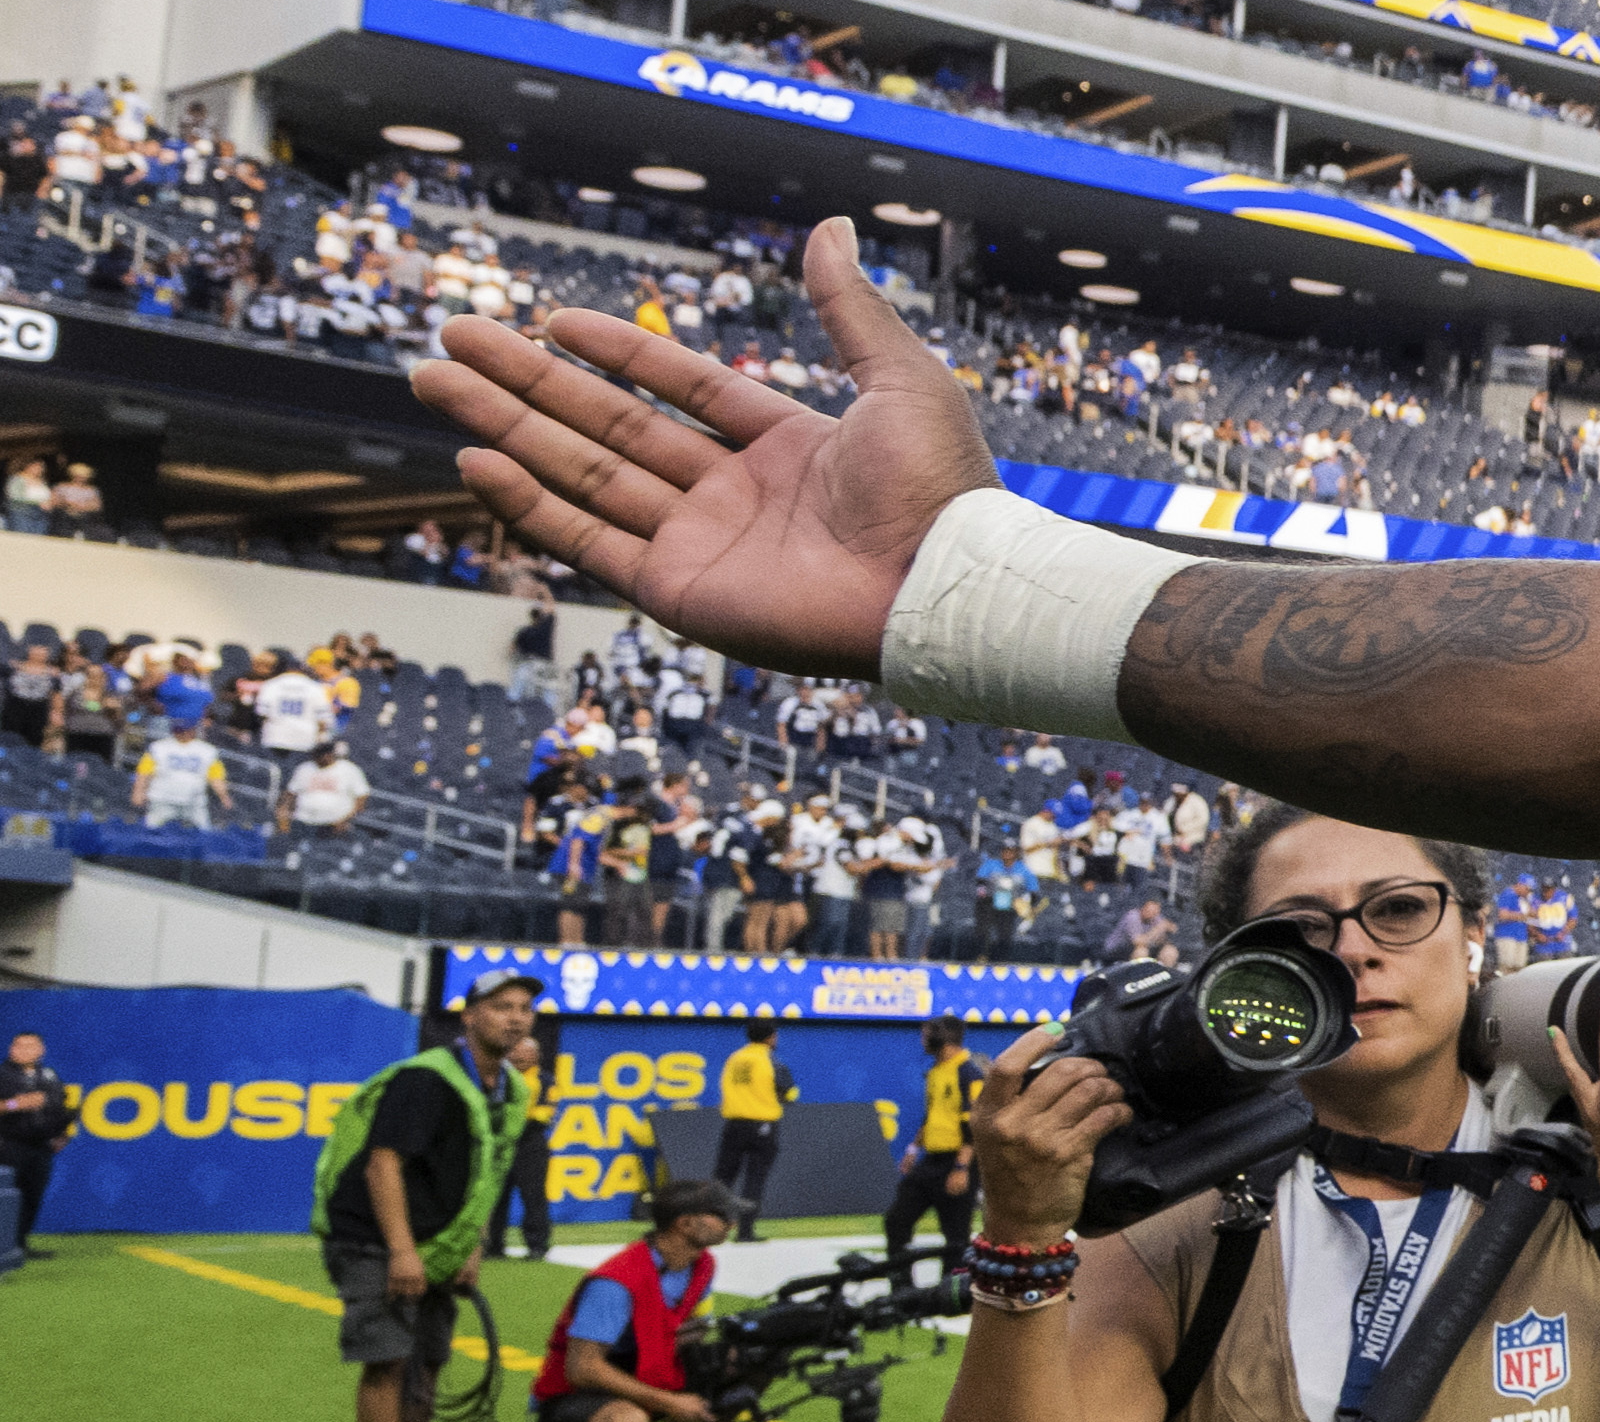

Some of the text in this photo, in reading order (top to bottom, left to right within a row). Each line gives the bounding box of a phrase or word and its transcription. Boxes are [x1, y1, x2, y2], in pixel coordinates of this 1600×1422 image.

[708, 70, 856, 123] RAMS
[1124, 970, 1172, 993] Canon
[555, 1052, 707, 1101] LOS
[65, 1081, 366, 1141] OUSE
[1354, 1237, 1385, 1326] STADIUM
[1359, 1231, 1430, 1363] AT&T STADIUM
[1504, 1347, 1561, 1388] NFL
